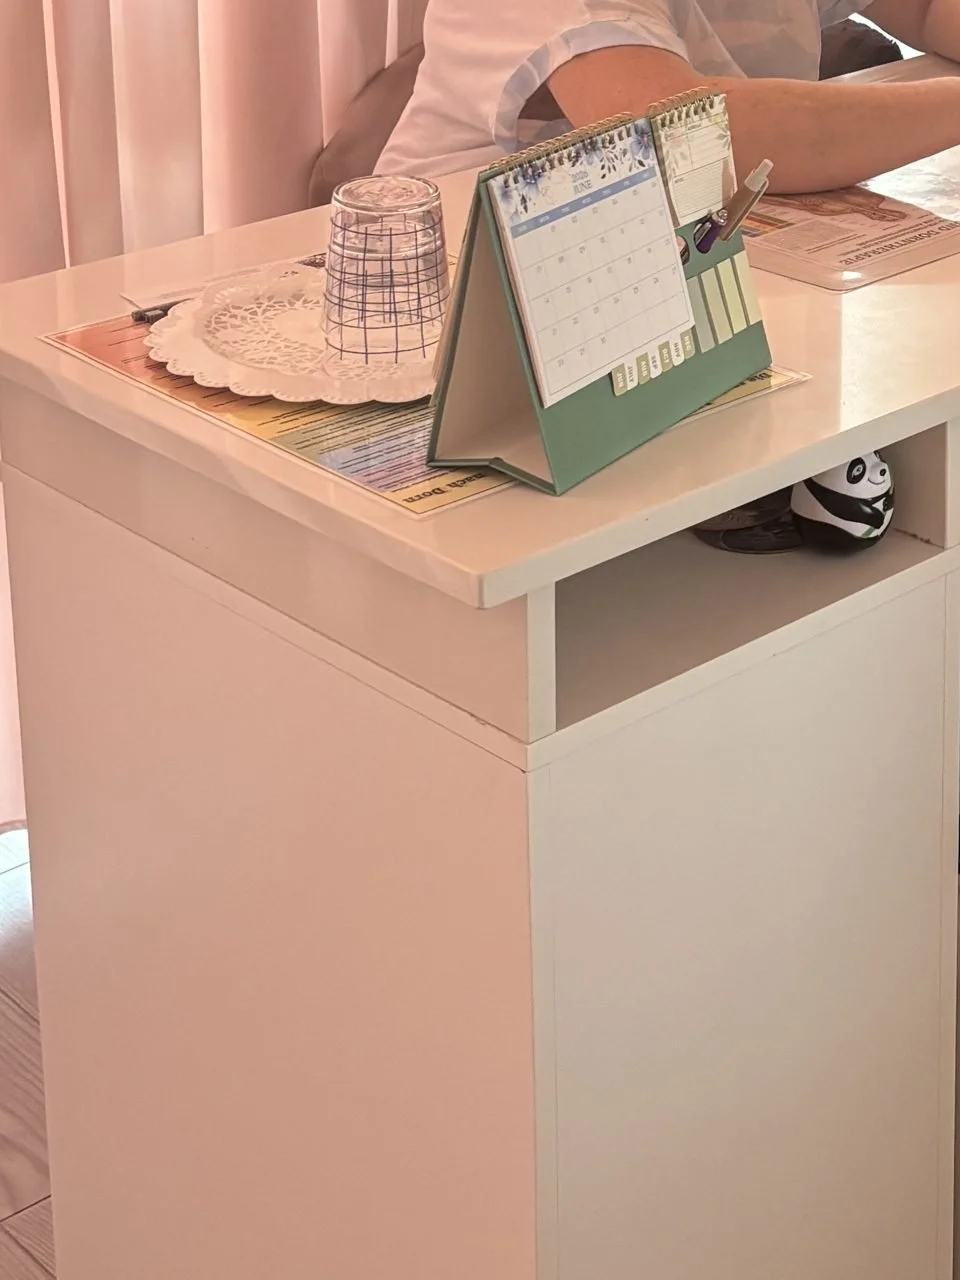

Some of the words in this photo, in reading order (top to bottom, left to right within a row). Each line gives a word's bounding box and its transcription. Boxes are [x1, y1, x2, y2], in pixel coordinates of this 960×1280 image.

[573, 180, 593, 195] JUNE
[673, 342, 681, 358] NOV
[651, 355, 659, 370] SEP
[616, 372, 624, 388] JUN
[446, 472, 487, 489] nach
[403, 487, 448, 504] Dorn
